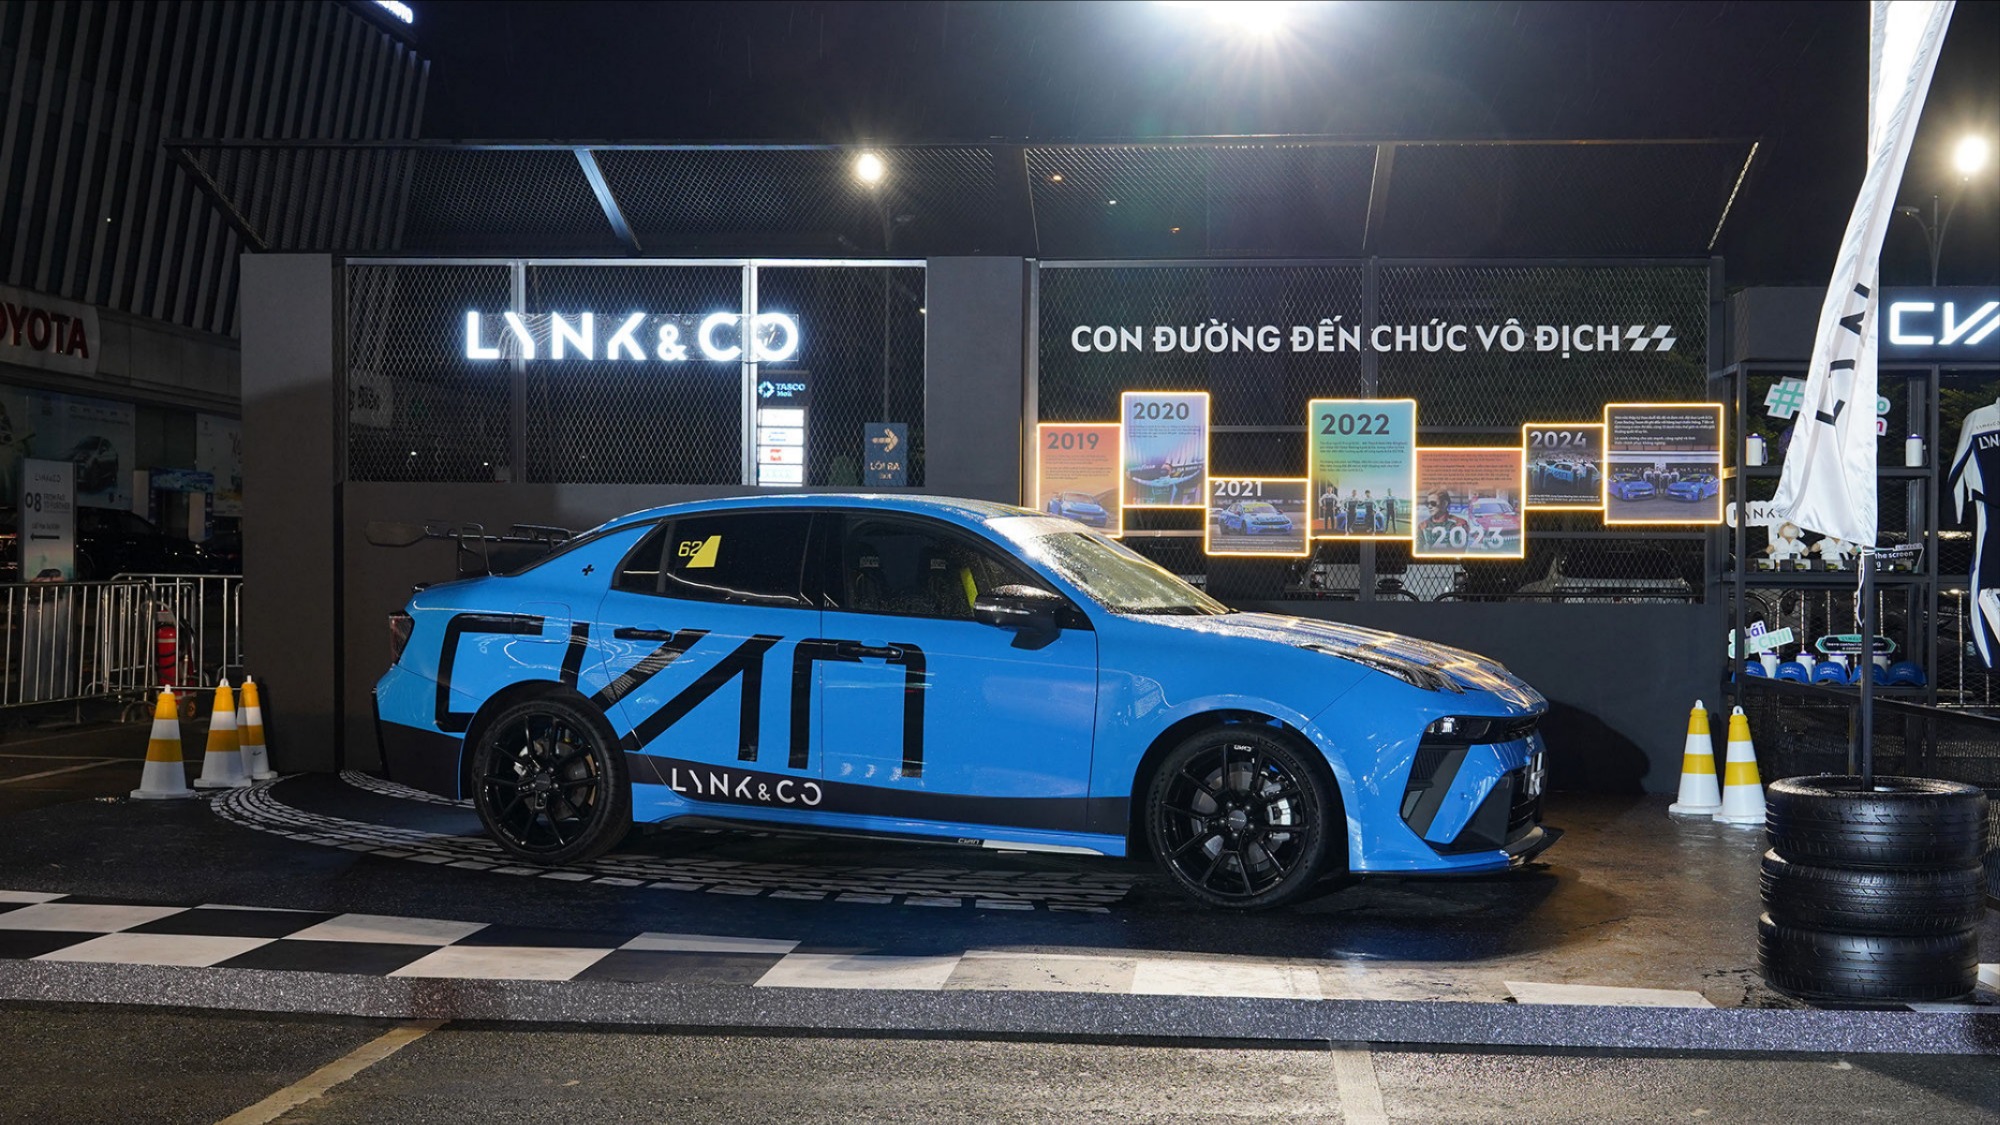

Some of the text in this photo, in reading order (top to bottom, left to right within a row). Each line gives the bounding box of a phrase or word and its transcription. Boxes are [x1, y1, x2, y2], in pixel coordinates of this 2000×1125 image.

[467, 311, 799, 361] LYNK&CO
[1072, 315, 1620, 358] CON ĐƯỜNG ĐẾN CHỨC VÔ ĐỊCH
[775, 383, 806, 391] TASCO
[1133, 402, 1190, 420] 2020
[1320, 413, 1390, 435] 2022
[1047, 432, 1100, 449] 2019
[1530, 431, 1587, 449] 2024
[1214, 480, 1263, 497] 2021
[1431, 526, 1505, 549] 2023
[678, 541, 703, 557] 62
[671, 767, 823, 806] LYNK&CO
